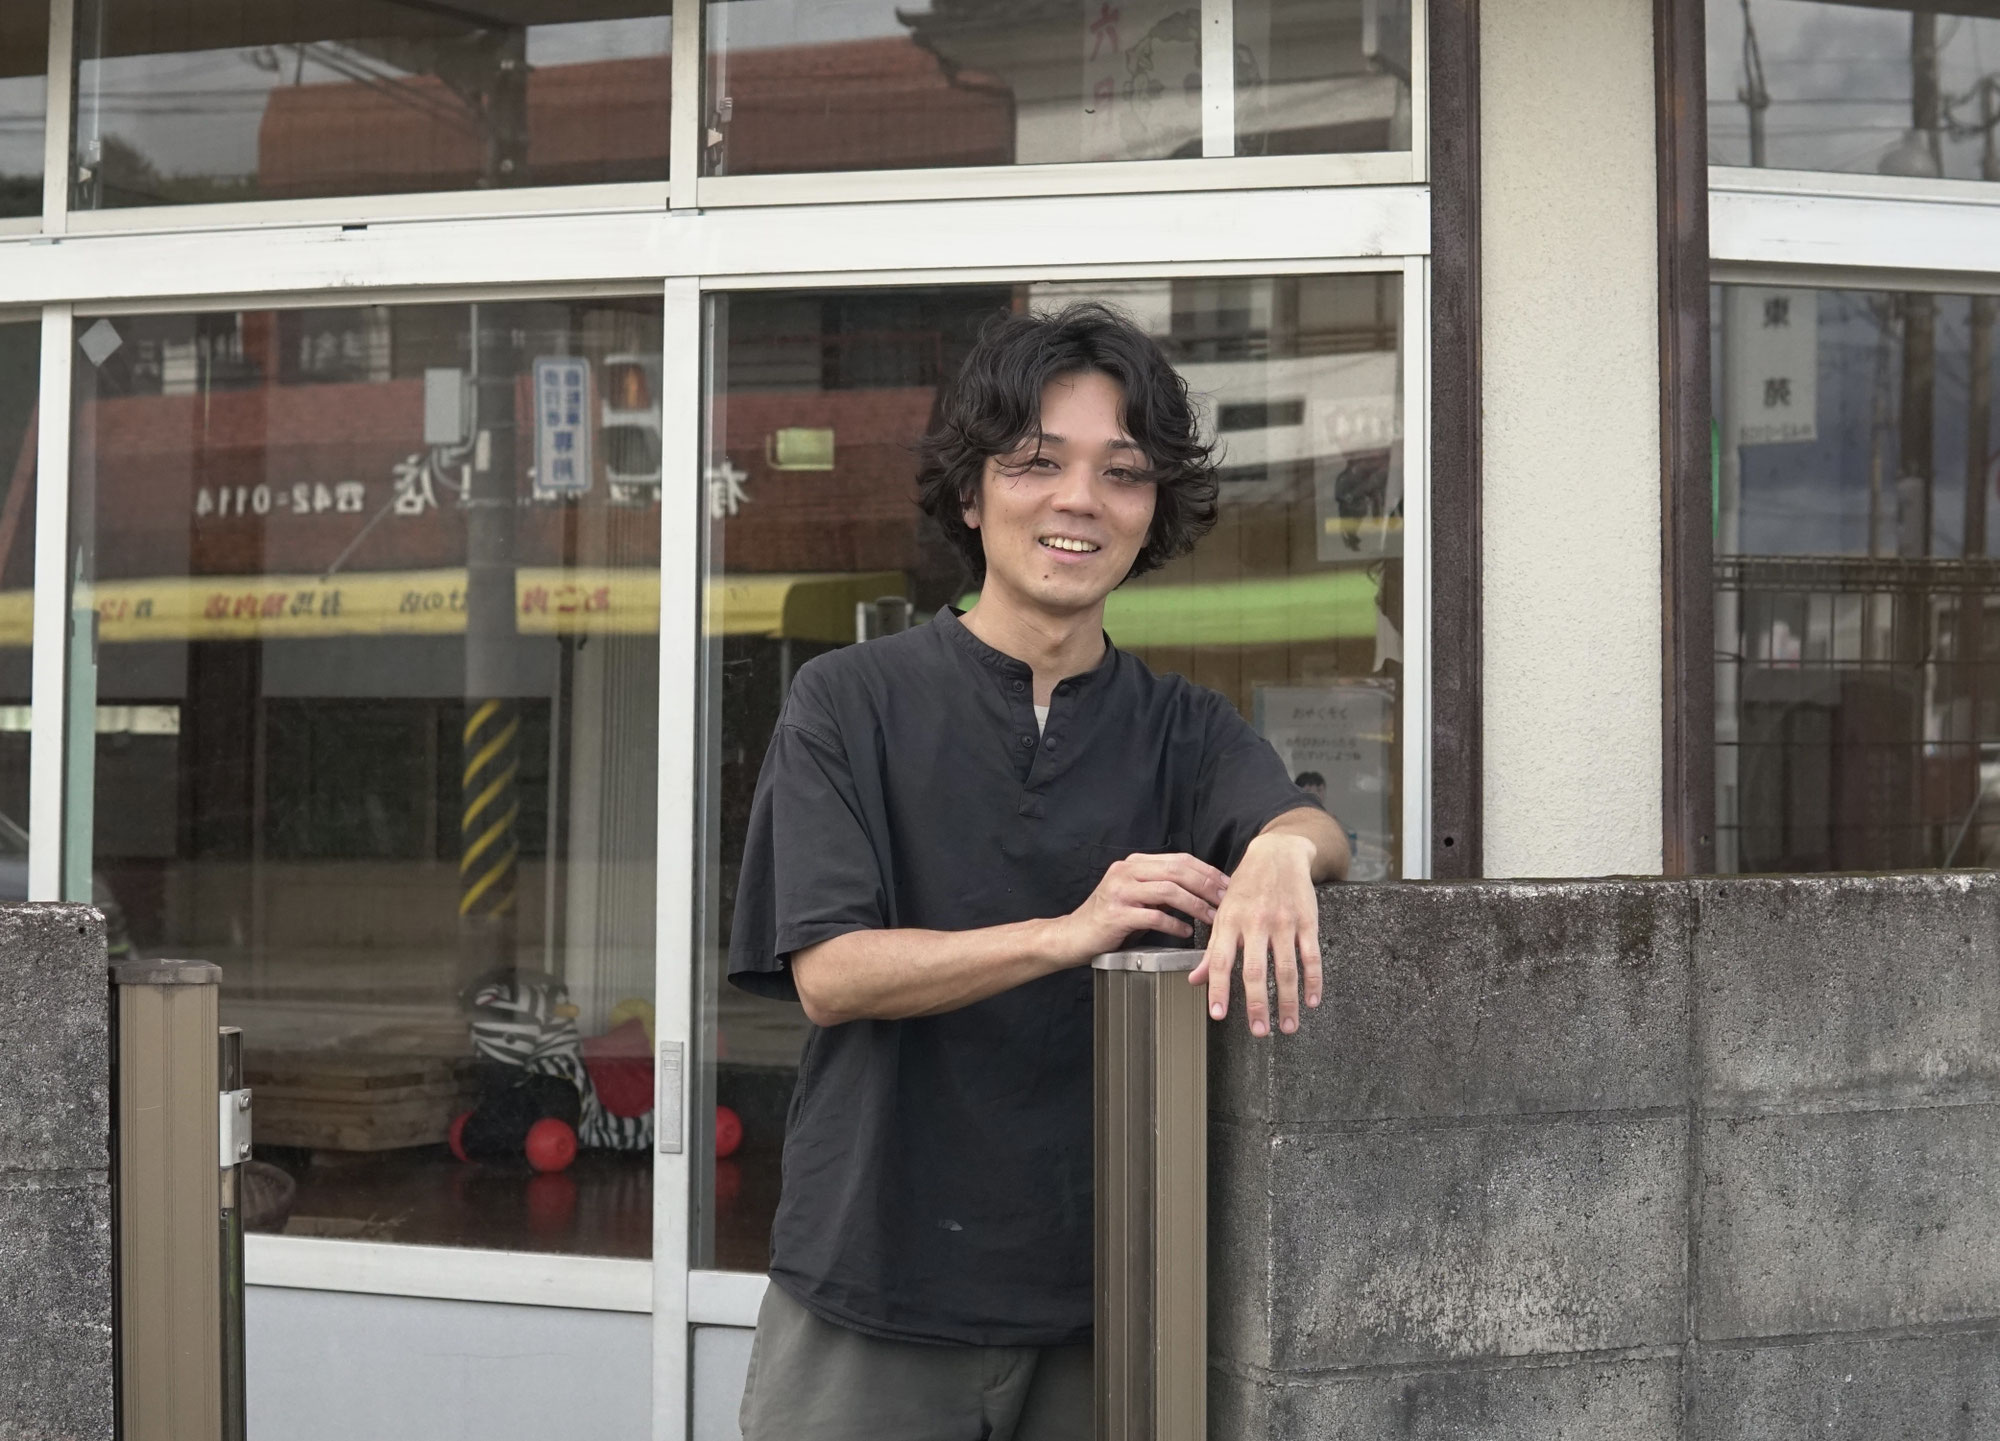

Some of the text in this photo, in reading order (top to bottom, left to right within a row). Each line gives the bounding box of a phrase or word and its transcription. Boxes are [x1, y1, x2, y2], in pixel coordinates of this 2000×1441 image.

[1292, 706, 1348, 721] おやくそく
